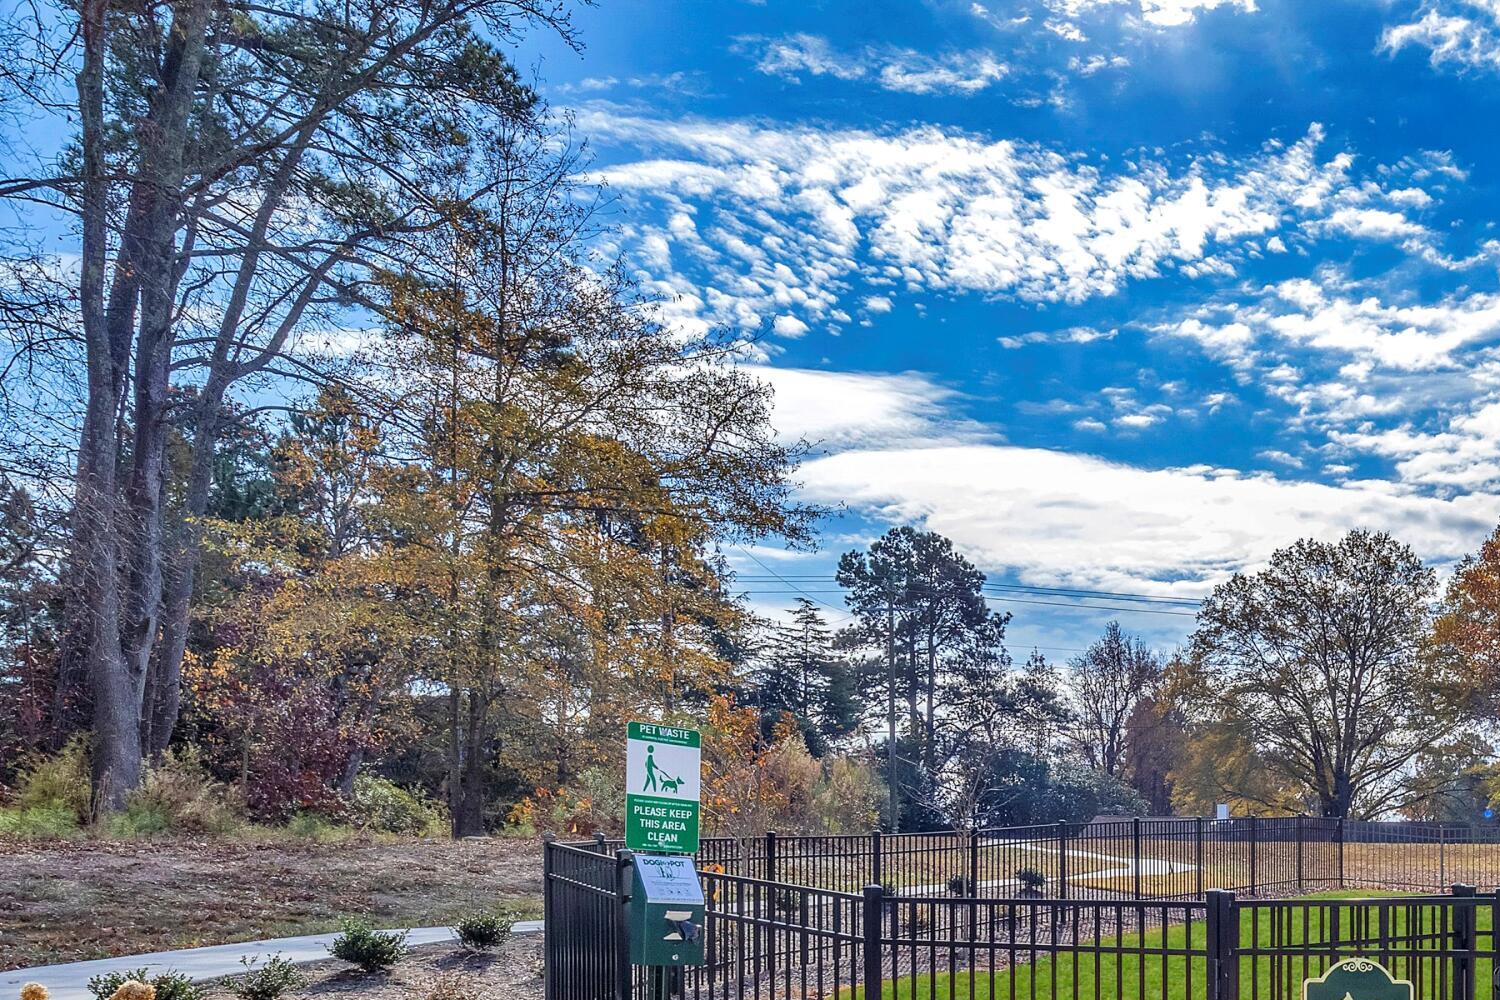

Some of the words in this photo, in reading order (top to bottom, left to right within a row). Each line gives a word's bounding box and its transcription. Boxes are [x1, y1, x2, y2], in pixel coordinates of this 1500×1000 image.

[639, 724, 657, 735] PET
[659, 727, 690, 740] WASTE
[633, 805, 667, 817] PLEASE
[669, 809, 693, 819] KEEP
[640, 818, 660, 829] THIS
[661, 821, 686, 831] AREA
[647, 832, 678, 842] CLEAN
